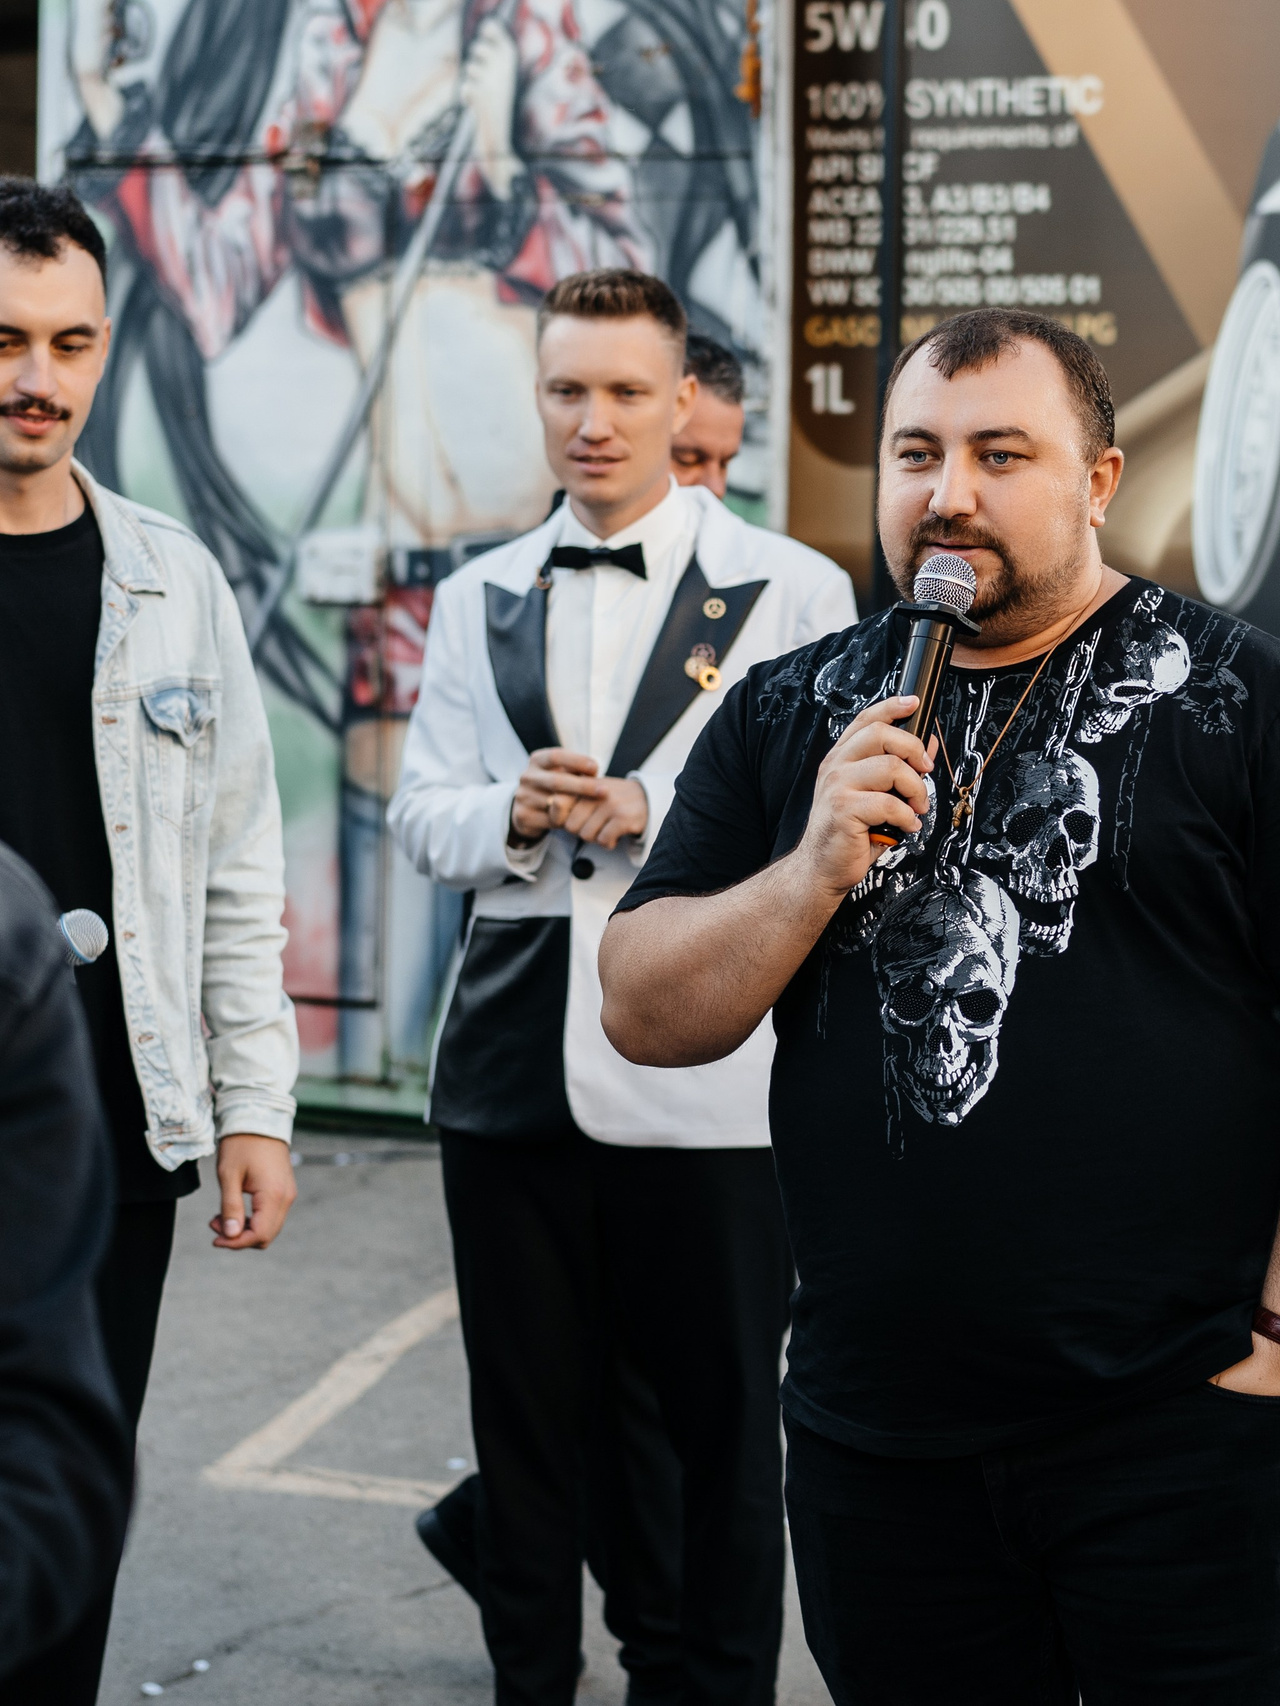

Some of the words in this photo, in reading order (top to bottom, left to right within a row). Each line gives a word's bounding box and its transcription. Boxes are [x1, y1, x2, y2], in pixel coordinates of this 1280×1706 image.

[805, 0, 950, 52] 5W0
[904, 75, 1104, 119] SYNTHETIC
[910, 124, 1051, 153] requirements
[1054, 121, 1080, 149] of
[807, 186, 883, 215] ACEA
[808, 247, 877, 276] BMW
[807, 277, 851, 306] VW
[805, 363, 856, 415] 1L
